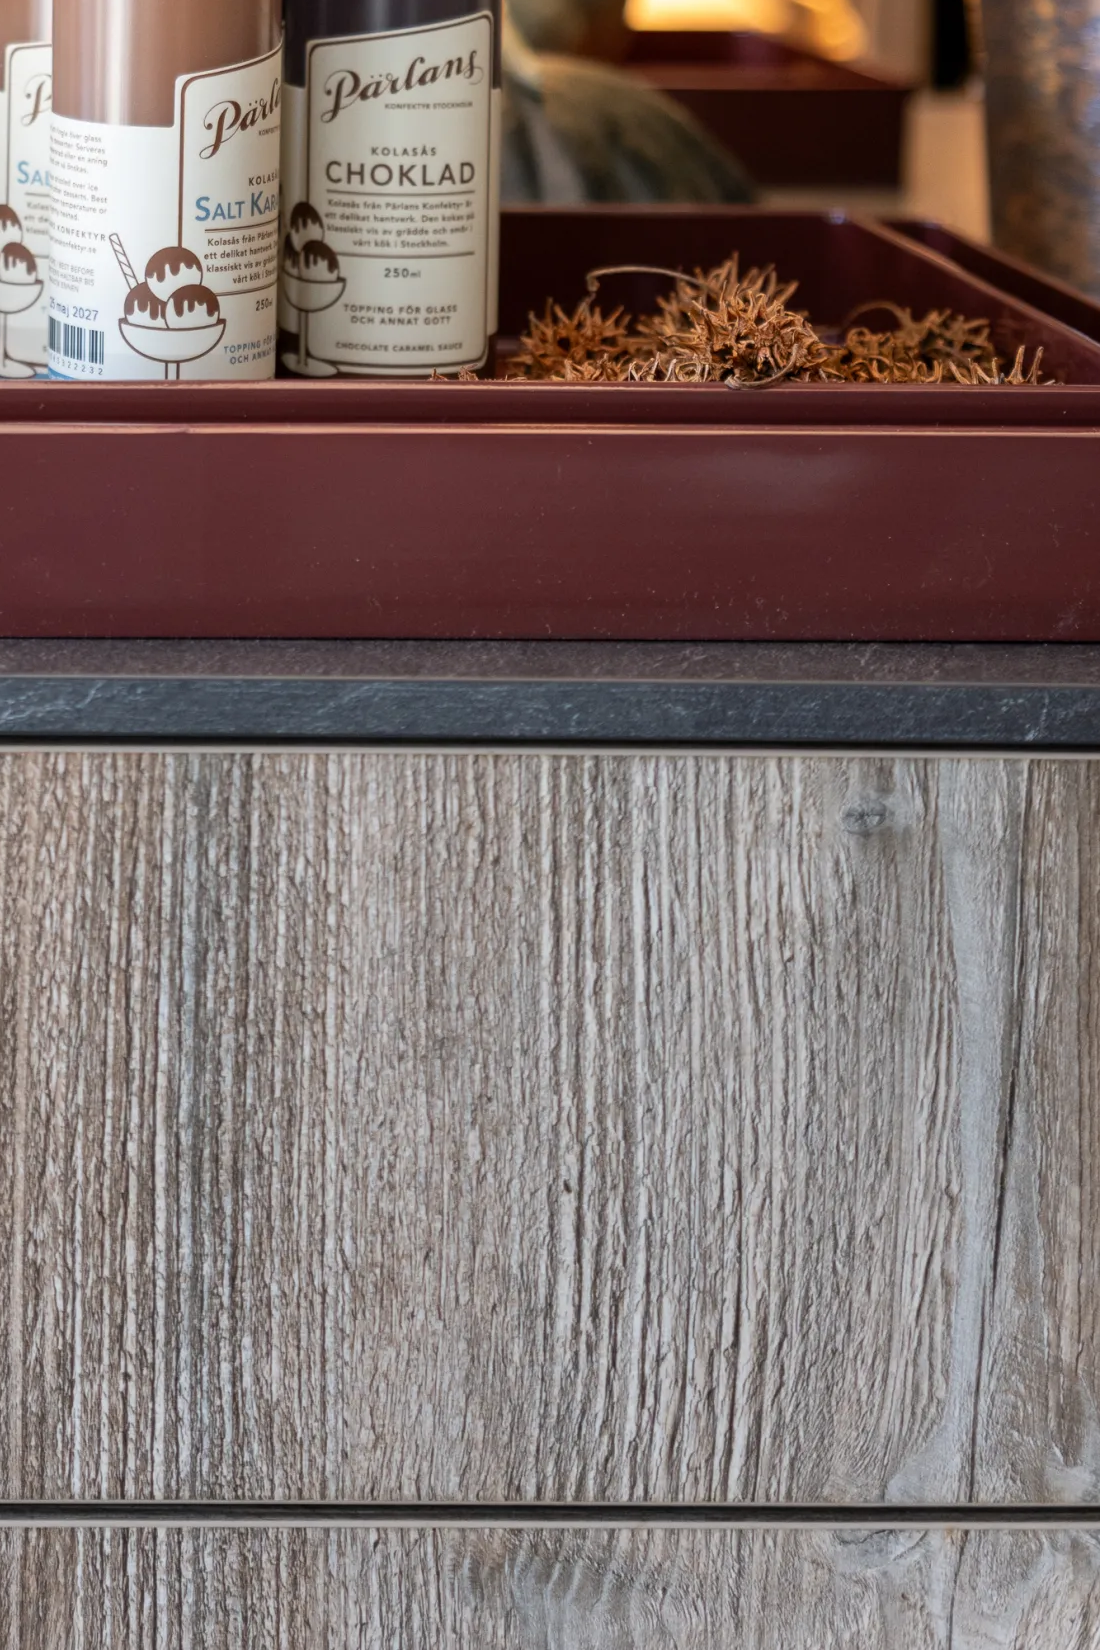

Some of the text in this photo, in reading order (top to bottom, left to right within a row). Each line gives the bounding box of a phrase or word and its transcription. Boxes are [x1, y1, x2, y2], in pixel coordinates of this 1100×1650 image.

[320, 50, 484, 124] Pärlans
[75, 141, 106, 155] Serveras
[371, 145, 437, 158] KOLASÅS
[87, 156, 108, 168] aning
[325, 160, 475, 187] CHOKLAD
[90, 193, 108, 204] Best
[363, 200, 382, 210] från
[385, 201, 420, 211] Pärlans
[339, 211, 370, 222] delikat
[421, 212, 439, 223] Den
[56, 224, 106, 242] KONFEKTYR
[326, 223, 364, 234] klassiskt
[366, 225, 379, 235] vis
[382, 227, 393, 235] av
[396, 225, 429, 237] grädde
[432, 225, 448, 235] och
[207, 235, 240, 247] Kolasås
[242, 233, 256, 243] från
[352, 238, 371, 248] vårt
[374, 238, 391, 248] kök
[400, 238, 450, 249] Stockholm.
[203, 251, 218, 260] ett
[220, 249, 248, 259] delikat
[70, 264, 95, 277] BEFORE
[206, 262, 242, 273] klassiskt
[243, 260, 253, 269] vis
[232, 274, 248, 284] vårt
[249, 272, 261, 282] kök
[56, 301, 70, 318] maj
[72, 305, 99, 322] 2027
[343, 303, 458, 315] TOPPING FÖR GLASS
[379, 317, 419, 326] ANNAT
[424, 315, 452, 326] GOTT
[223, 340, 261, 355] TOPPING
[335, 341, 464, 352] CHOCOLATE CARAMEL SAUCE
[229, 354, 249, 365] OCH
